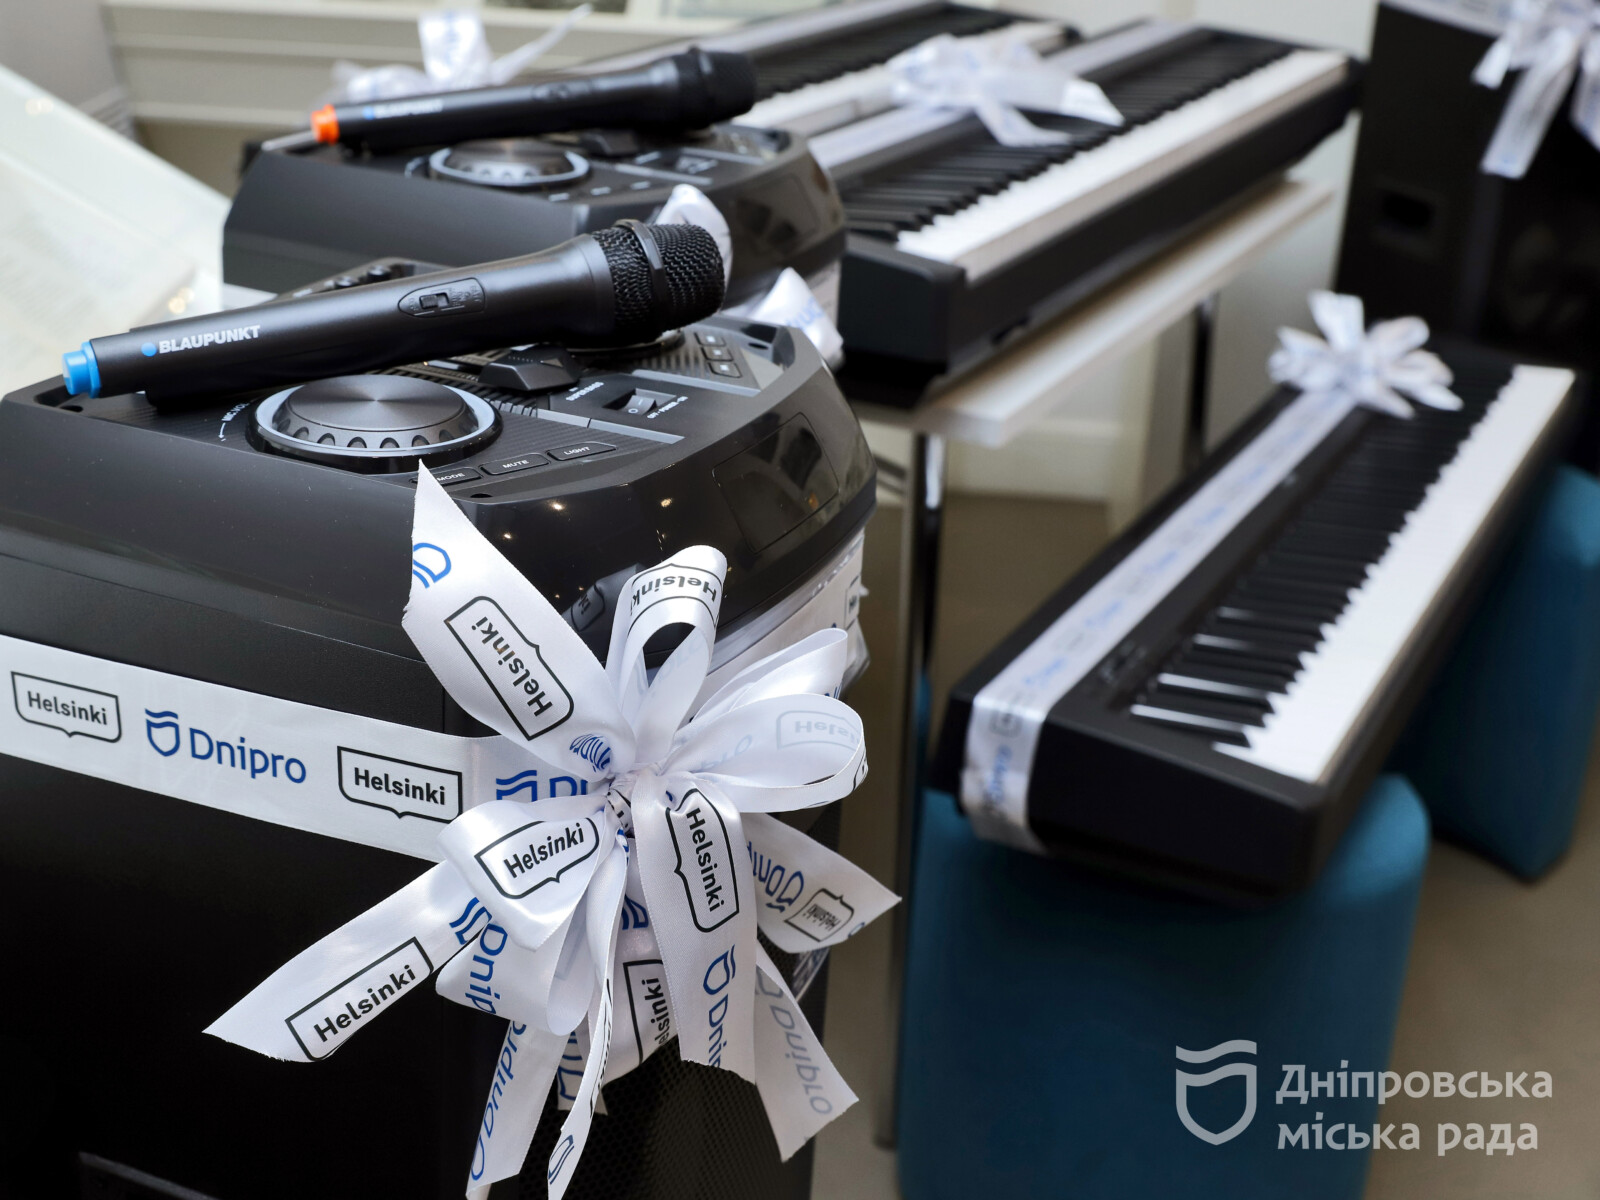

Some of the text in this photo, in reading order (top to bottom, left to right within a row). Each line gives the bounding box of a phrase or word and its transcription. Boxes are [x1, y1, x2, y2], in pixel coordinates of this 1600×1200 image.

[159, 325, 261, 354] BLAUPUNKT
[436, 472, 465, 482] MODE
[502, 459, 530, 469] MUTE
[564, 446, 591, 456] LIGHT
[631, 575, 717, 608] Helsink
[471, 616, 553, 718] Helsinki
[27, 690, 446, 806] Helsinki Dnipro Helsinki
[503, 822, 585, 879] Helsinki
[686, 807, 725, 912] Helsinki
[465, 923, 508, 1015] Dnip
[314, 964, 417, 1042] Helsinki
[641, 977, 671, 1046] elsinki
